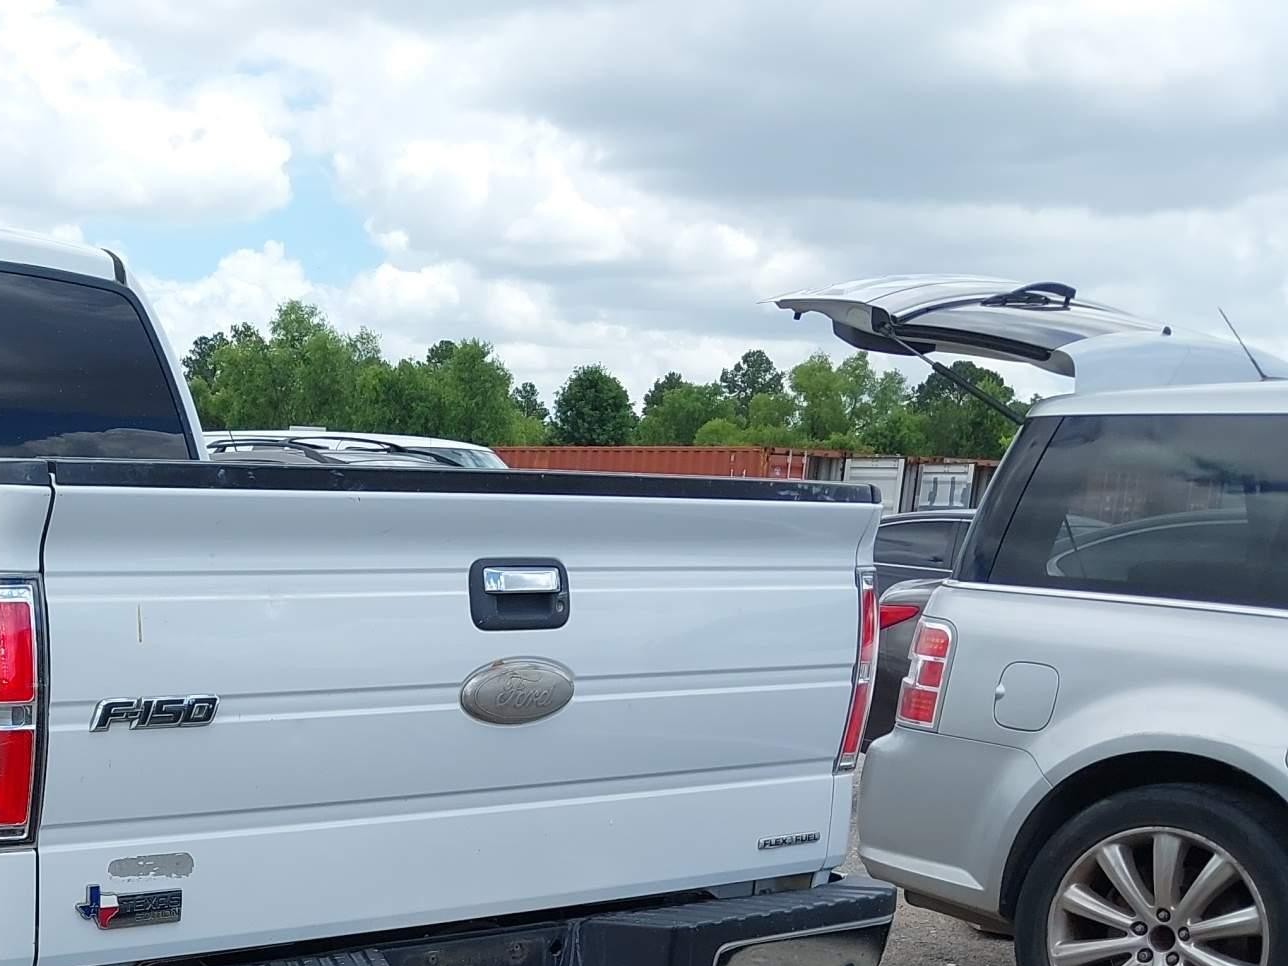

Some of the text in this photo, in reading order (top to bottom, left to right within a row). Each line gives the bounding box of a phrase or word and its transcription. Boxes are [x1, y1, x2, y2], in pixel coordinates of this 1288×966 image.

[497, 670, 556, 708] Ford
[89, 695, 220, 732] F-150
[123, 896, 180, 912] TEXAS
